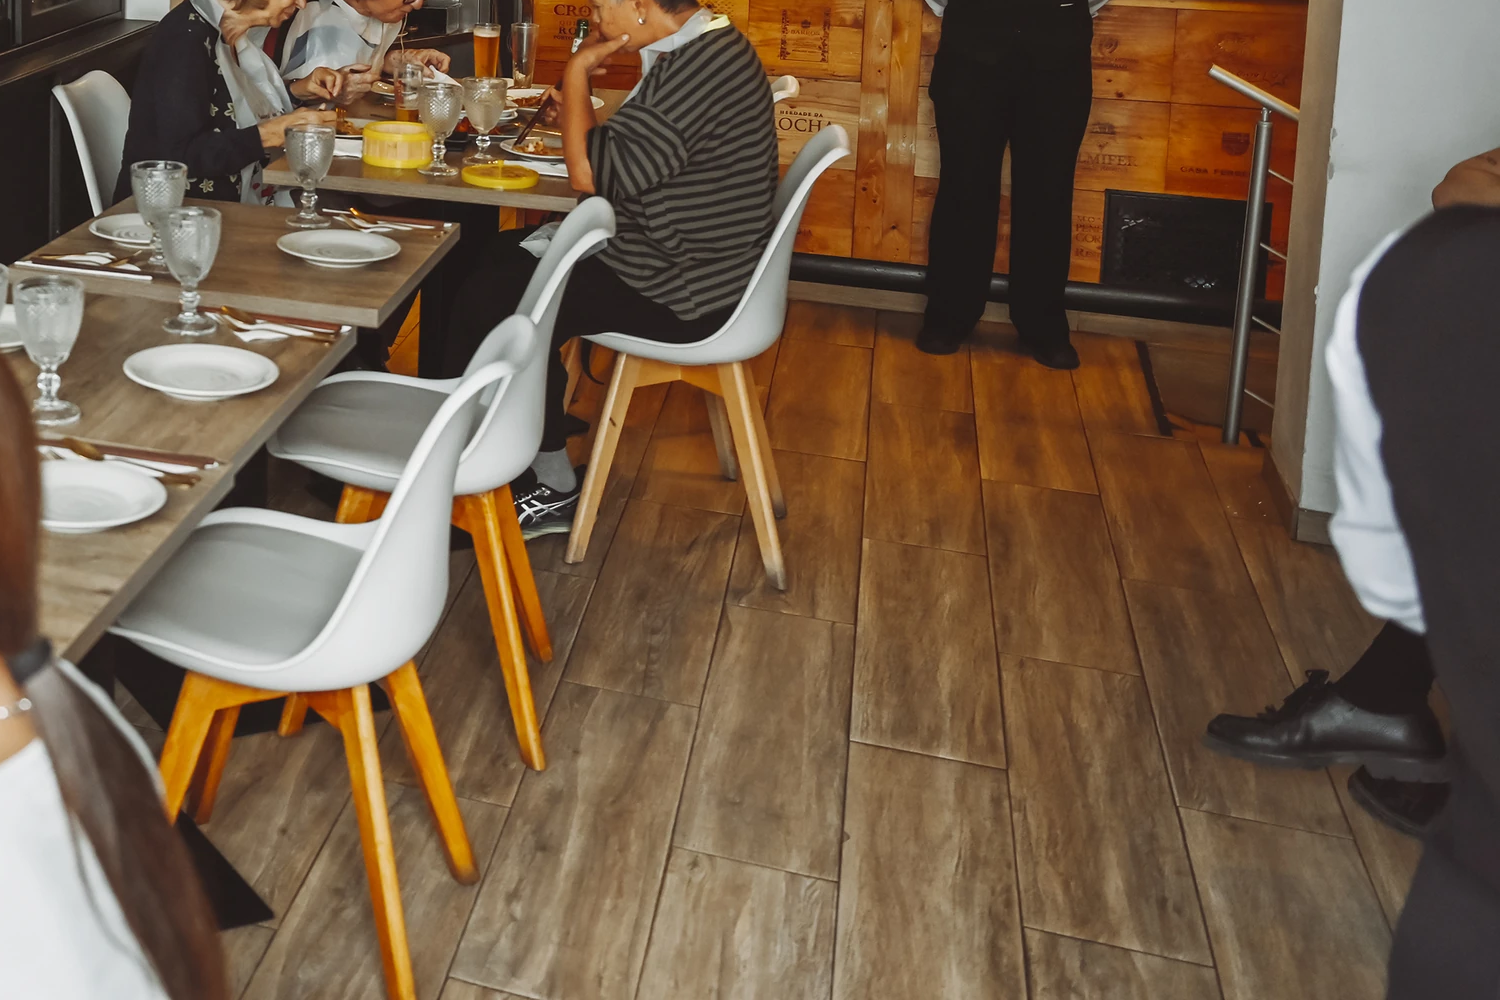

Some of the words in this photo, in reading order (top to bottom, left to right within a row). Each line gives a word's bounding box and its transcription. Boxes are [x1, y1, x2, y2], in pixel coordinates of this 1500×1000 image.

[554, 3, 592, 17] CRO
[776, 117, 833, 133] OCH
[1213, 168, 1249, 177] FERRE
